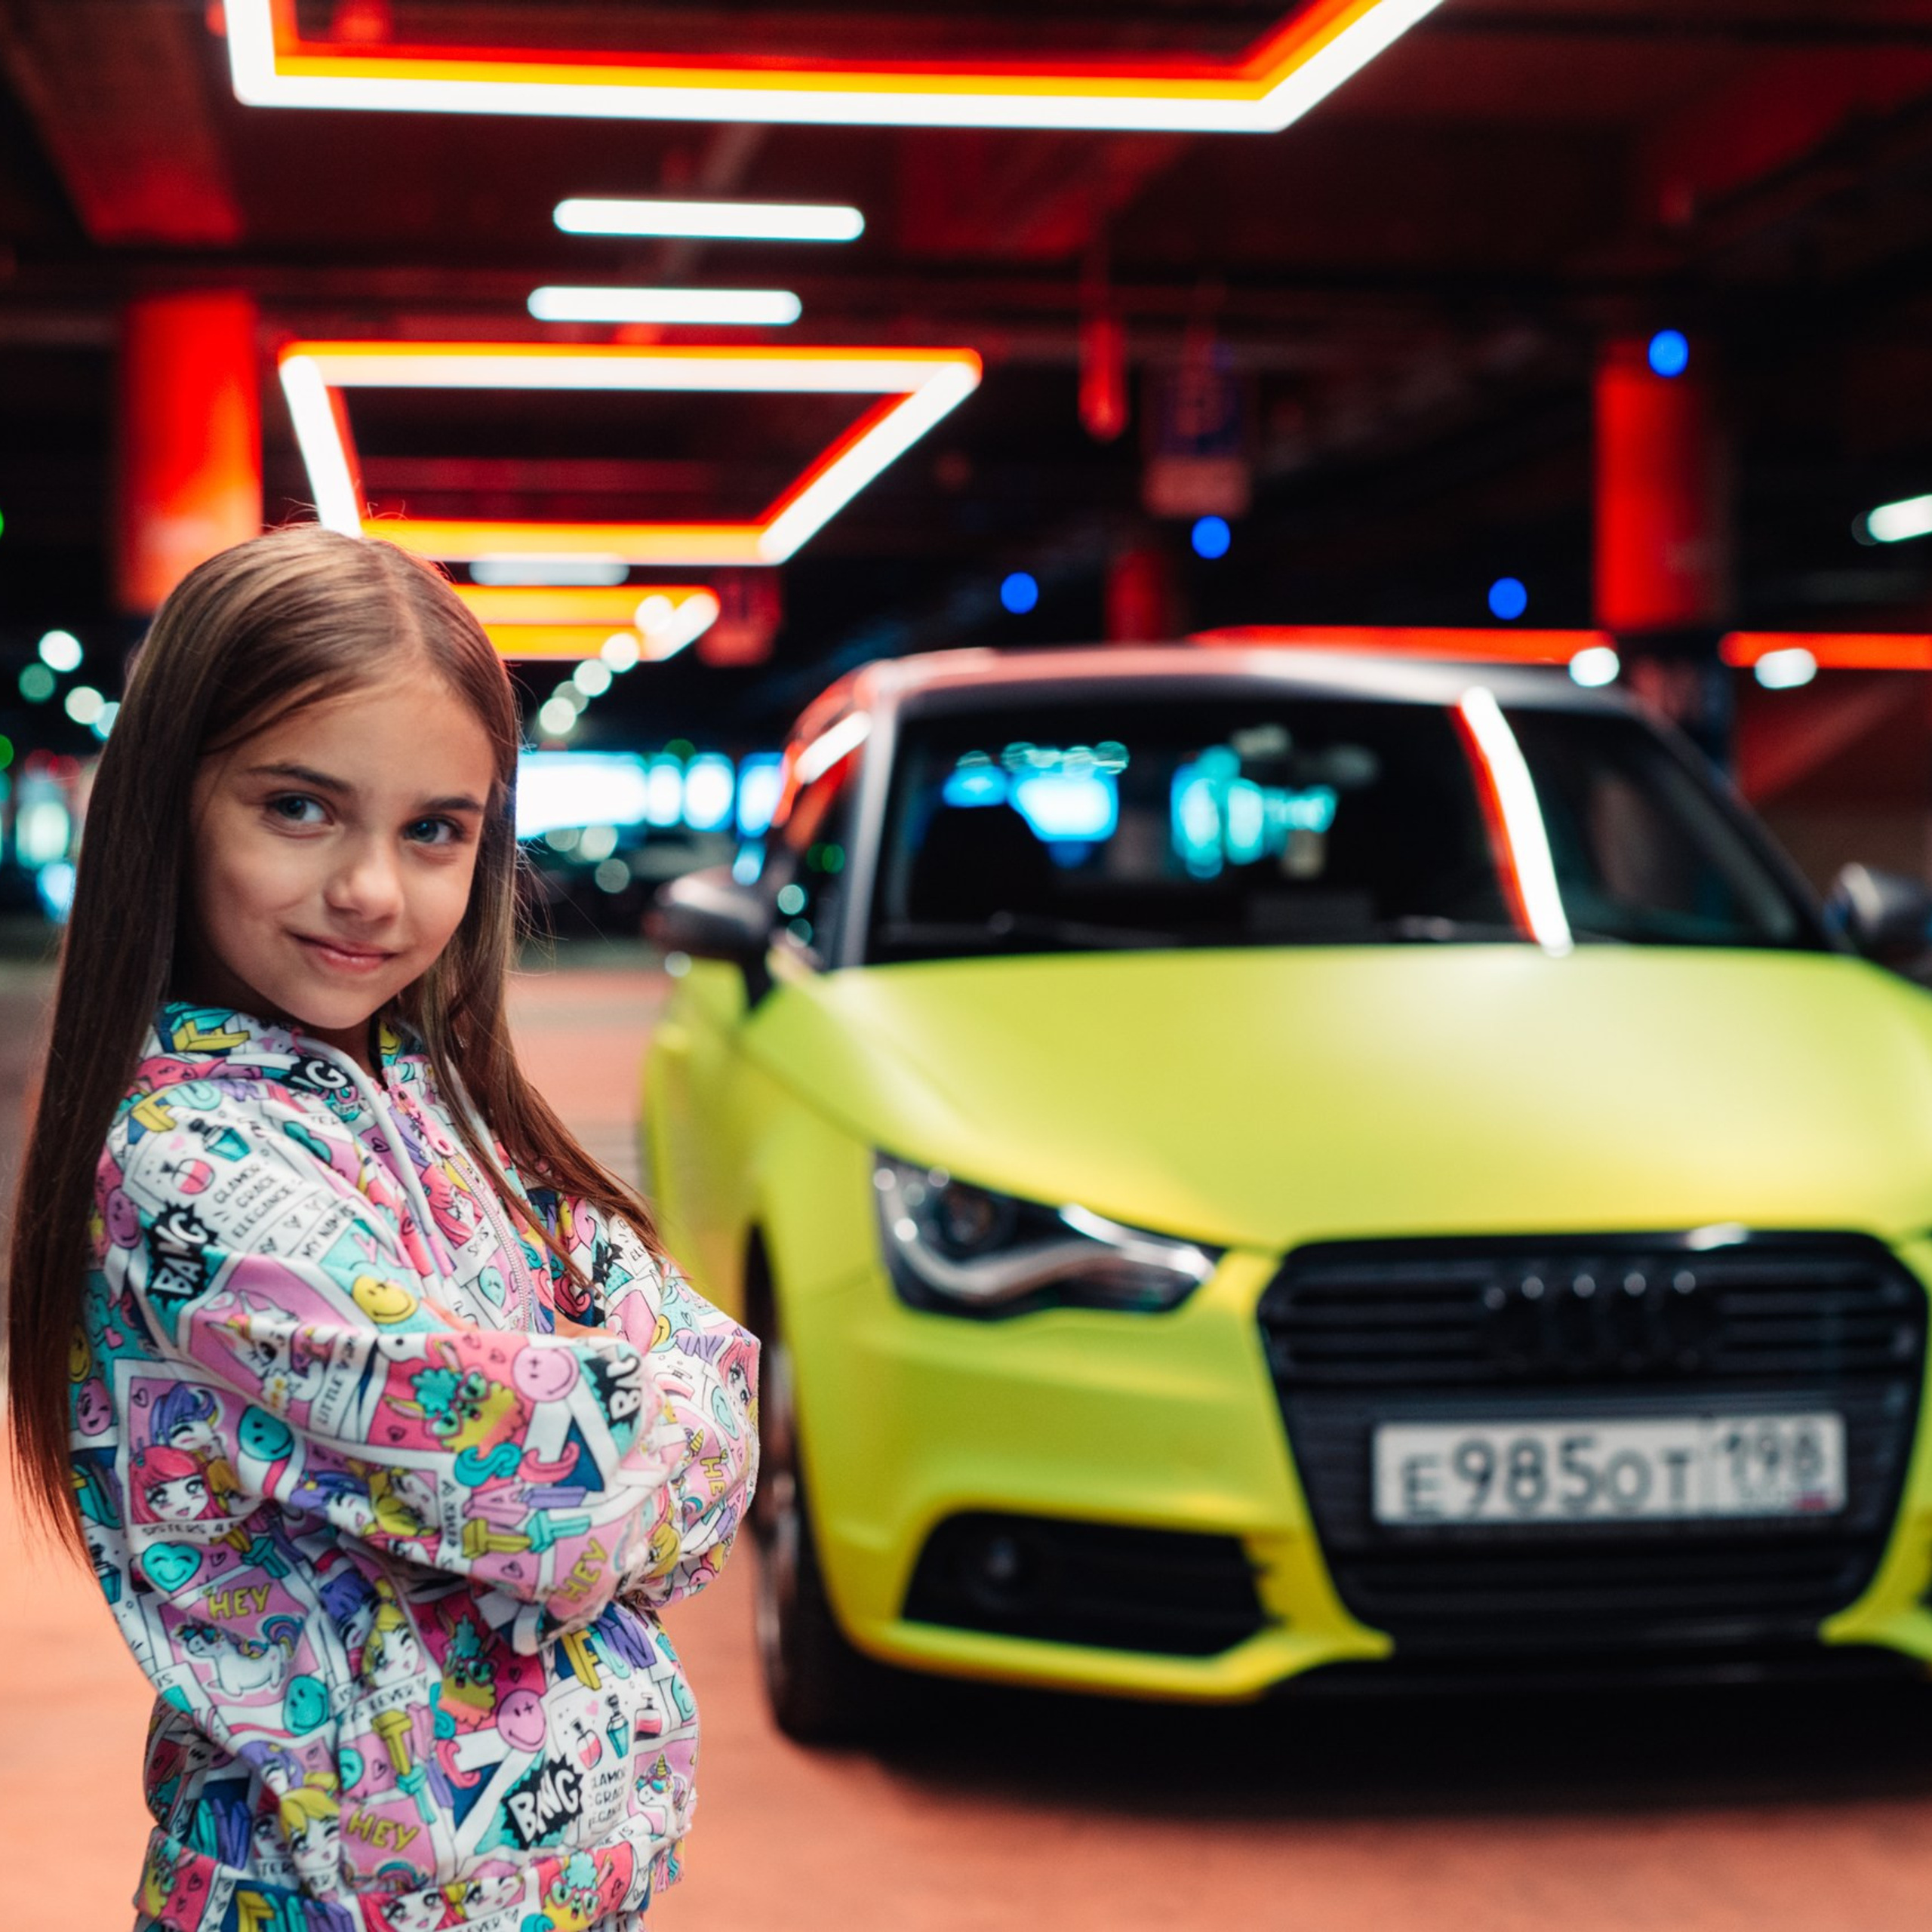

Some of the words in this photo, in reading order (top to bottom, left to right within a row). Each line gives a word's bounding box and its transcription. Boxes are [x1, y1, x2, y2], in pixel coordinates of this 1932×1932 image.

[559, 1537, 608, 1603] HEY
[208, 1584, 270, 1620] HEY
[348, 1811, 421, 1854] HEY
